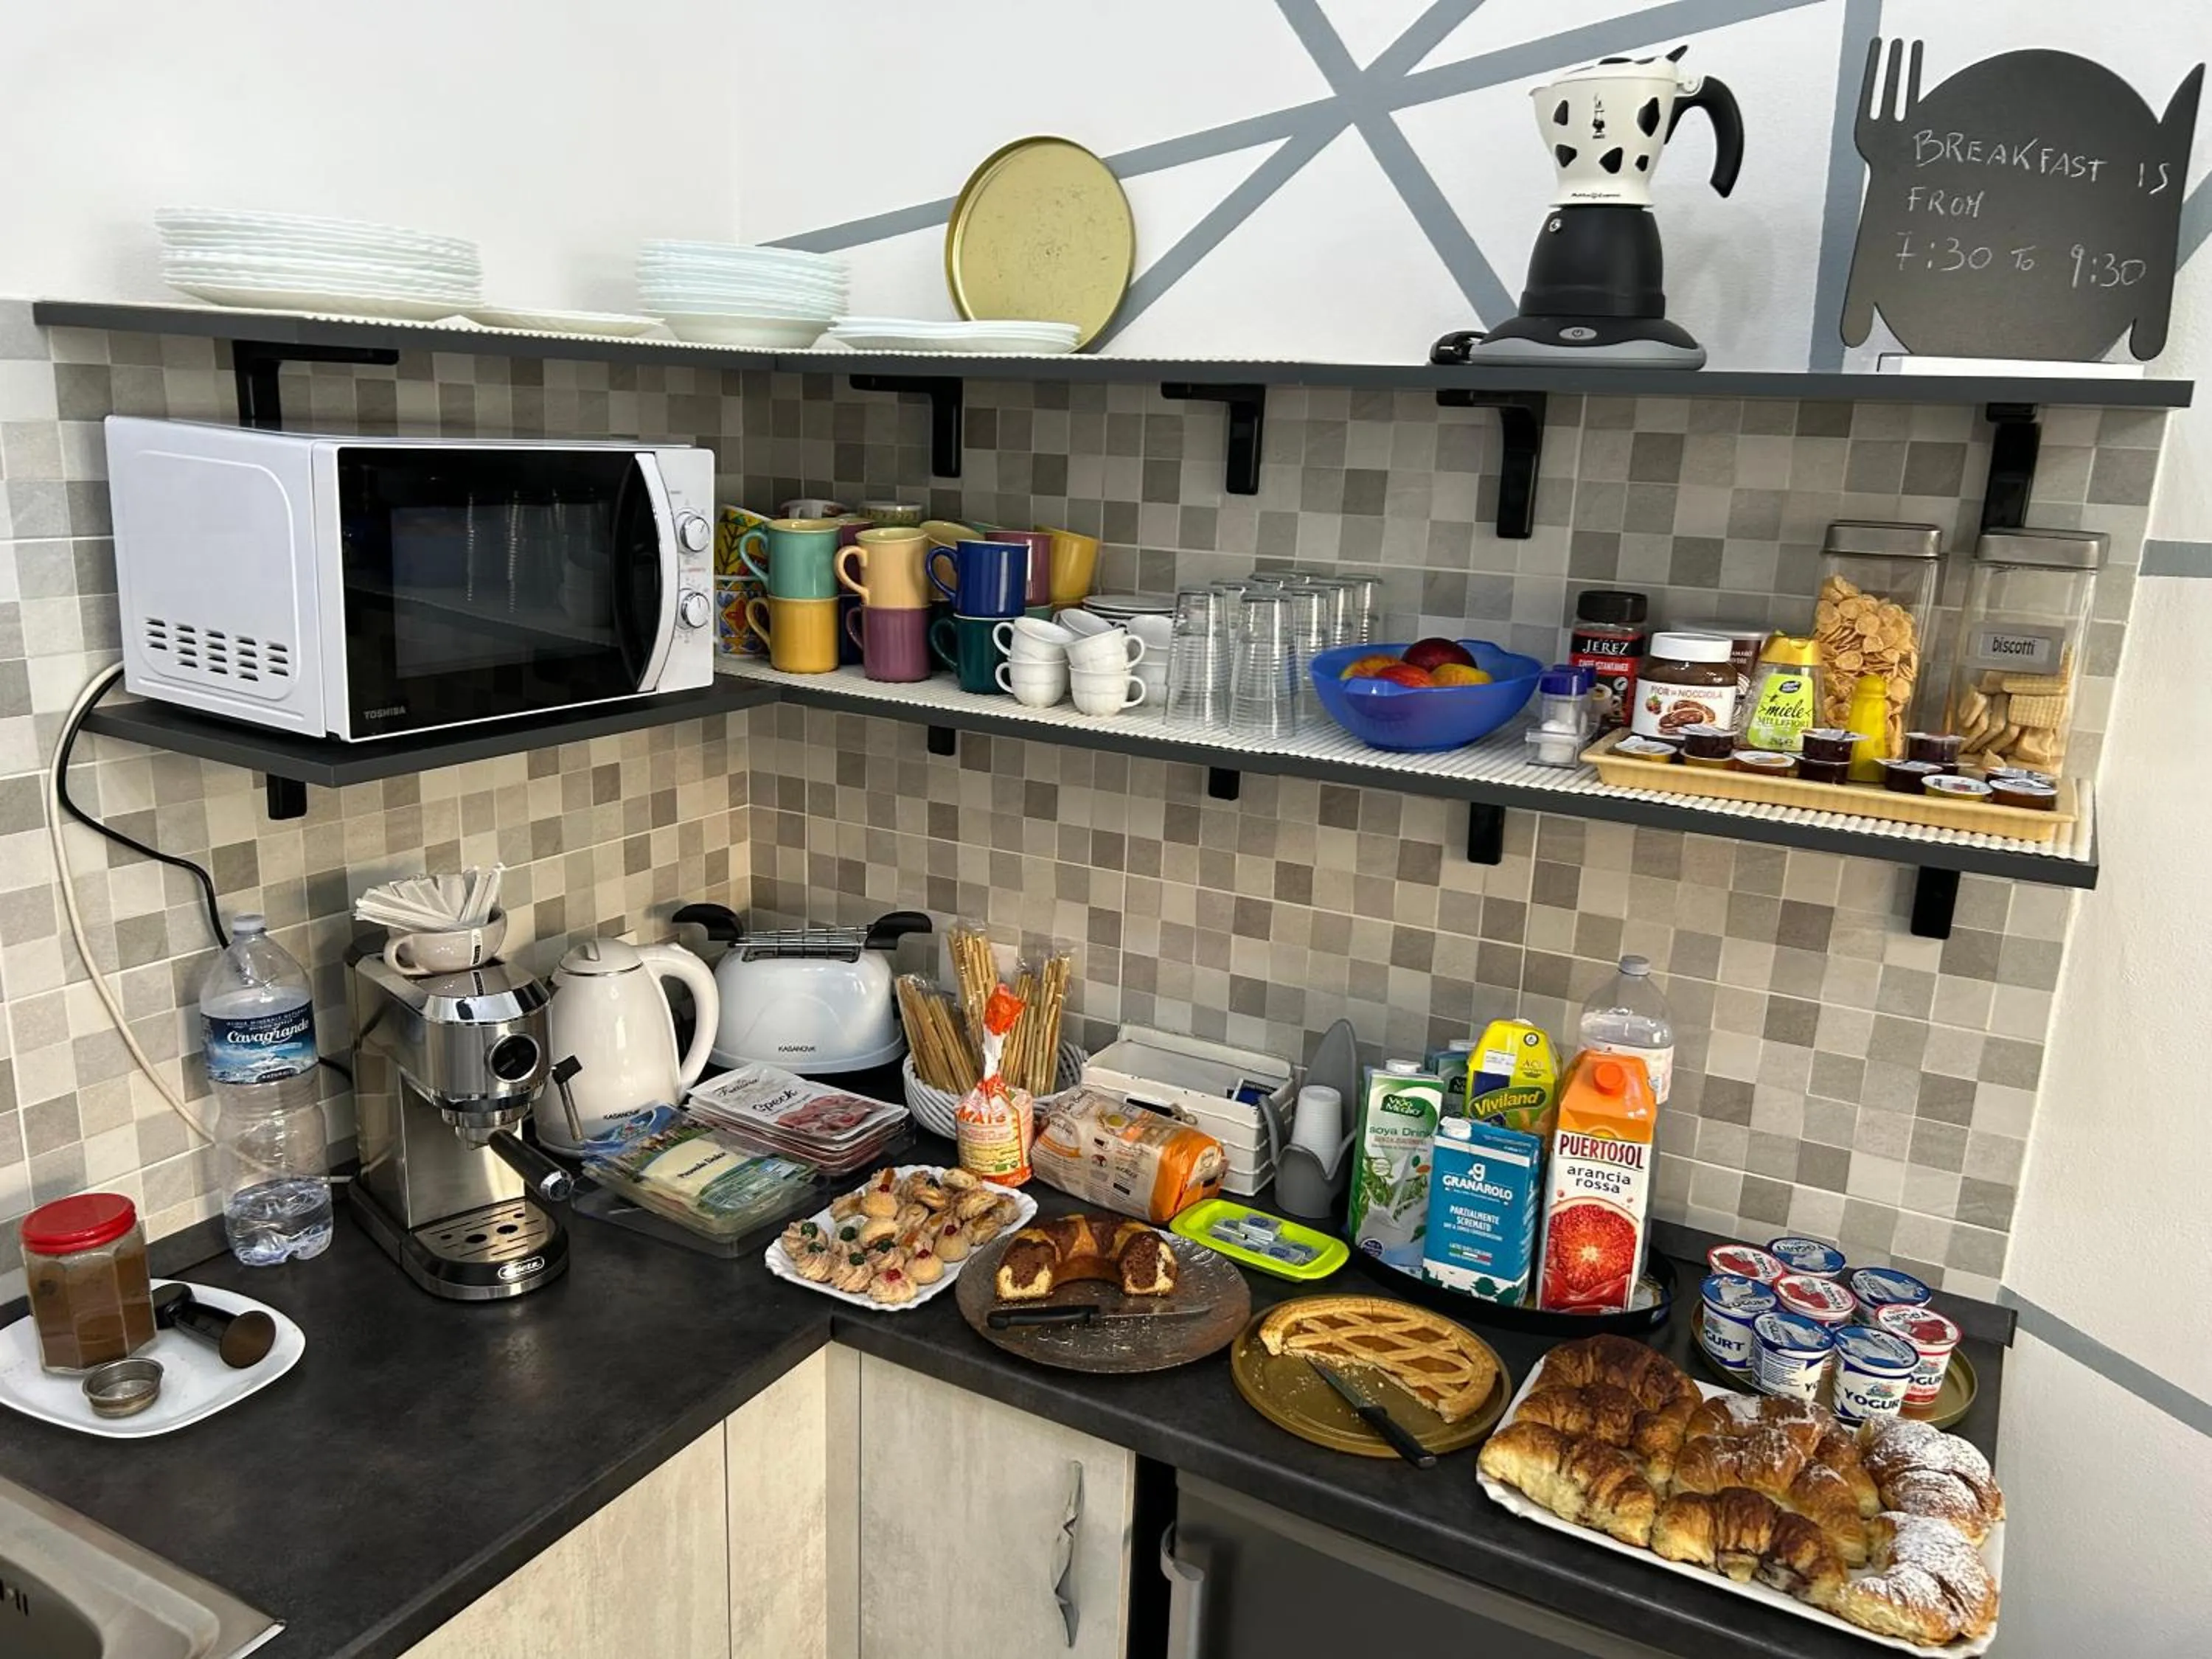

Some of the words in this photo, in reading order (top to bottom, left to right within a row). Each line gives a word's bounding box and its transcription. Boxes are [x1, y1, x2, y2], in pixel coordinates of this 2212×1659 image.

[1913, 130, 2108, 183] BREAKFAST
[2139, 163, 2171, 195] IS
[1908, 187, 1985, 218] FROM
[1895, 232, 1993, 271] 7:30
[2070, 244, 2146, 288] 9:30
[1582, 639, 1629, 655] JEREZ
[1992, 636, 2037, 655] biscotti
[364, 706, 406, 720] TOSHIBA
[1765, 699, 1805, 718] miele
[226, 1018, 310, 1045] Cavagrande
[1474, 1090, 1541, 1116] Viviland
[1559, 1134, 1644, 1170] PUERTOSOL
[1567, 1166, 1631, 1185] arancia
[1576, 1178, 1621, 1194] rossa
[1442, 1175, 1513, 1200] GRANAROLO
[1705, 1329, 1745, 1352] GURT
[1844, 1387, 1901, 1410] YOGUR
